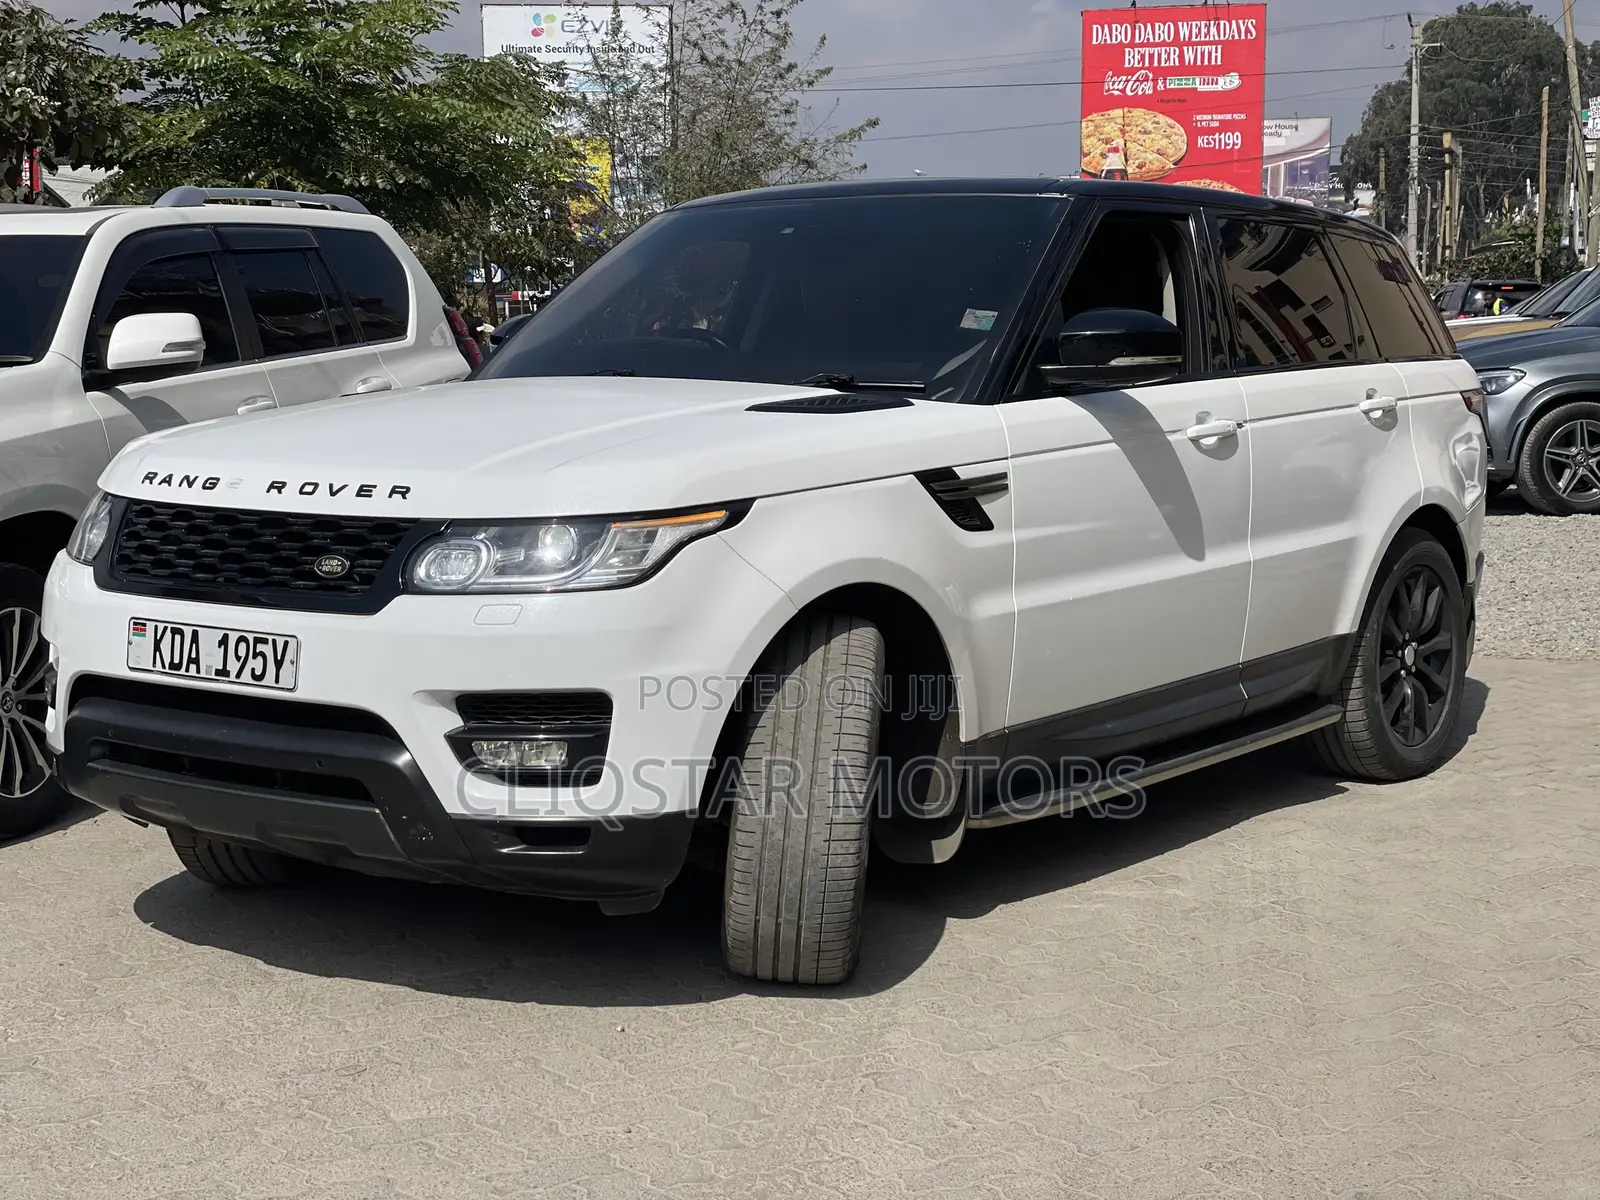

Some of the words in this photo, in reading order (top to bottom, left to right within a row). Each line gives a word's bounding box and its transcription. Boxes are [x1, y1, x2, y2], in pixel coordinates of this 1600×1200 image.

[561, 20, 621, 34] EZVI
[1092, 24, 1131, 45] DABO
[1135, 22, 1175, 43] DABO
[1178, 19, 1257, 42] WEEKDAYS
[501, 44, 543, 54] Ultimate
[545, 44, 584, 56] Security
[638, 44, 655, 54] Out
[1124, 47, 1180, 68] BETTER
[1183, 45, 1222, 66] WITH
[1157, 77, 1165, 91] &
[1168, 78, 1197, 86] PIZZA
[1199, 77, 1219, 86] INN
[265, 480, 412, 500] ROVER
[321, 565, 341, 573] ROVER
[152, 624, 201, 675] KDA
[214, 633, 289, 684] 195Y
